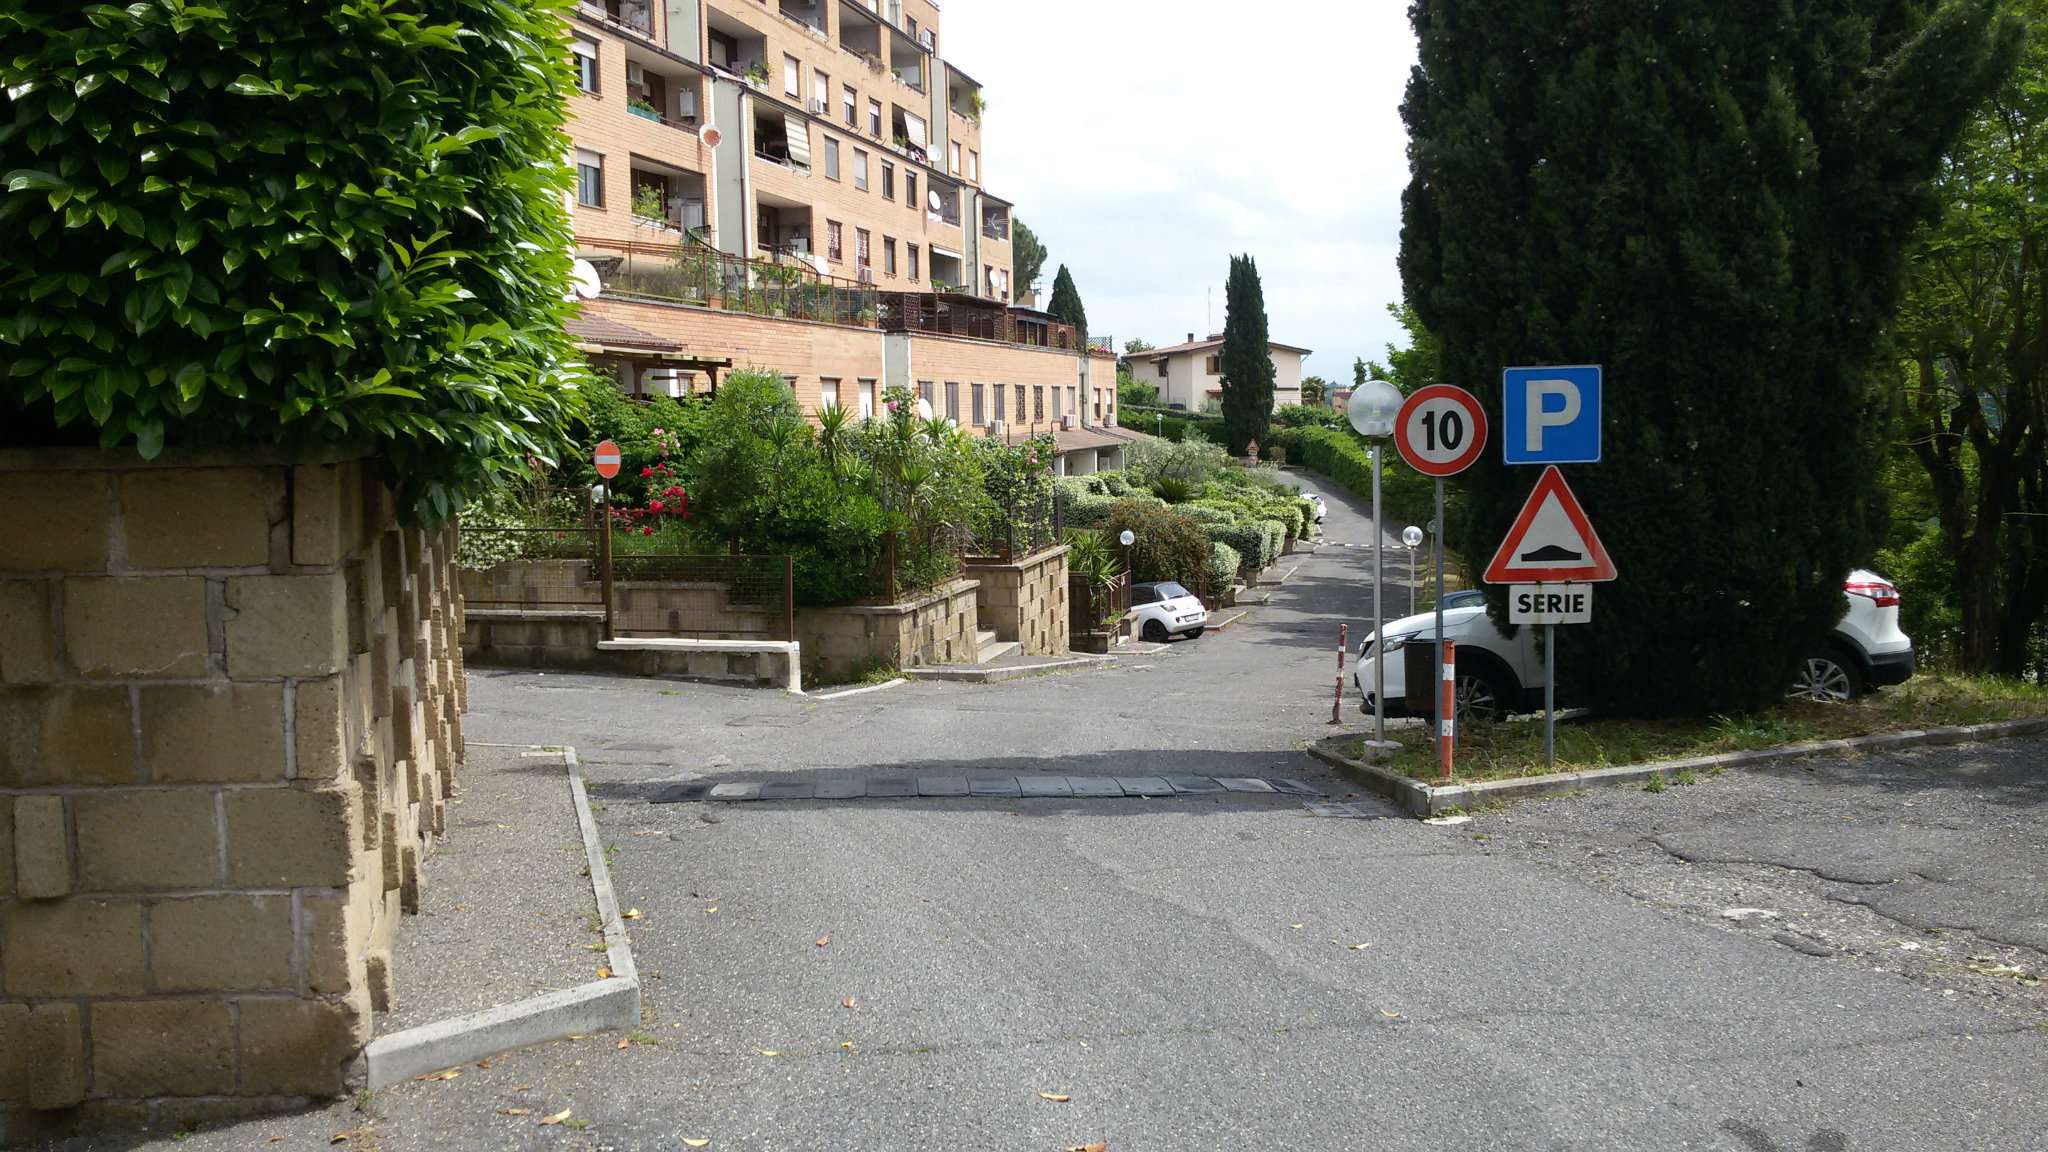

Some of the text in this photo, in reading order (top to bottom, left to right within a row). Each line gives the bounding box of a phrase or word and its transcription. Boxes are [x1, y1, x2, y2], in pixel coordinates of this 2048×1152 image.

[1421, 410, 1463, 451] 10
[1526, 380, 1581, 452] P
[1517, 593, 1584, 614] SERIE
